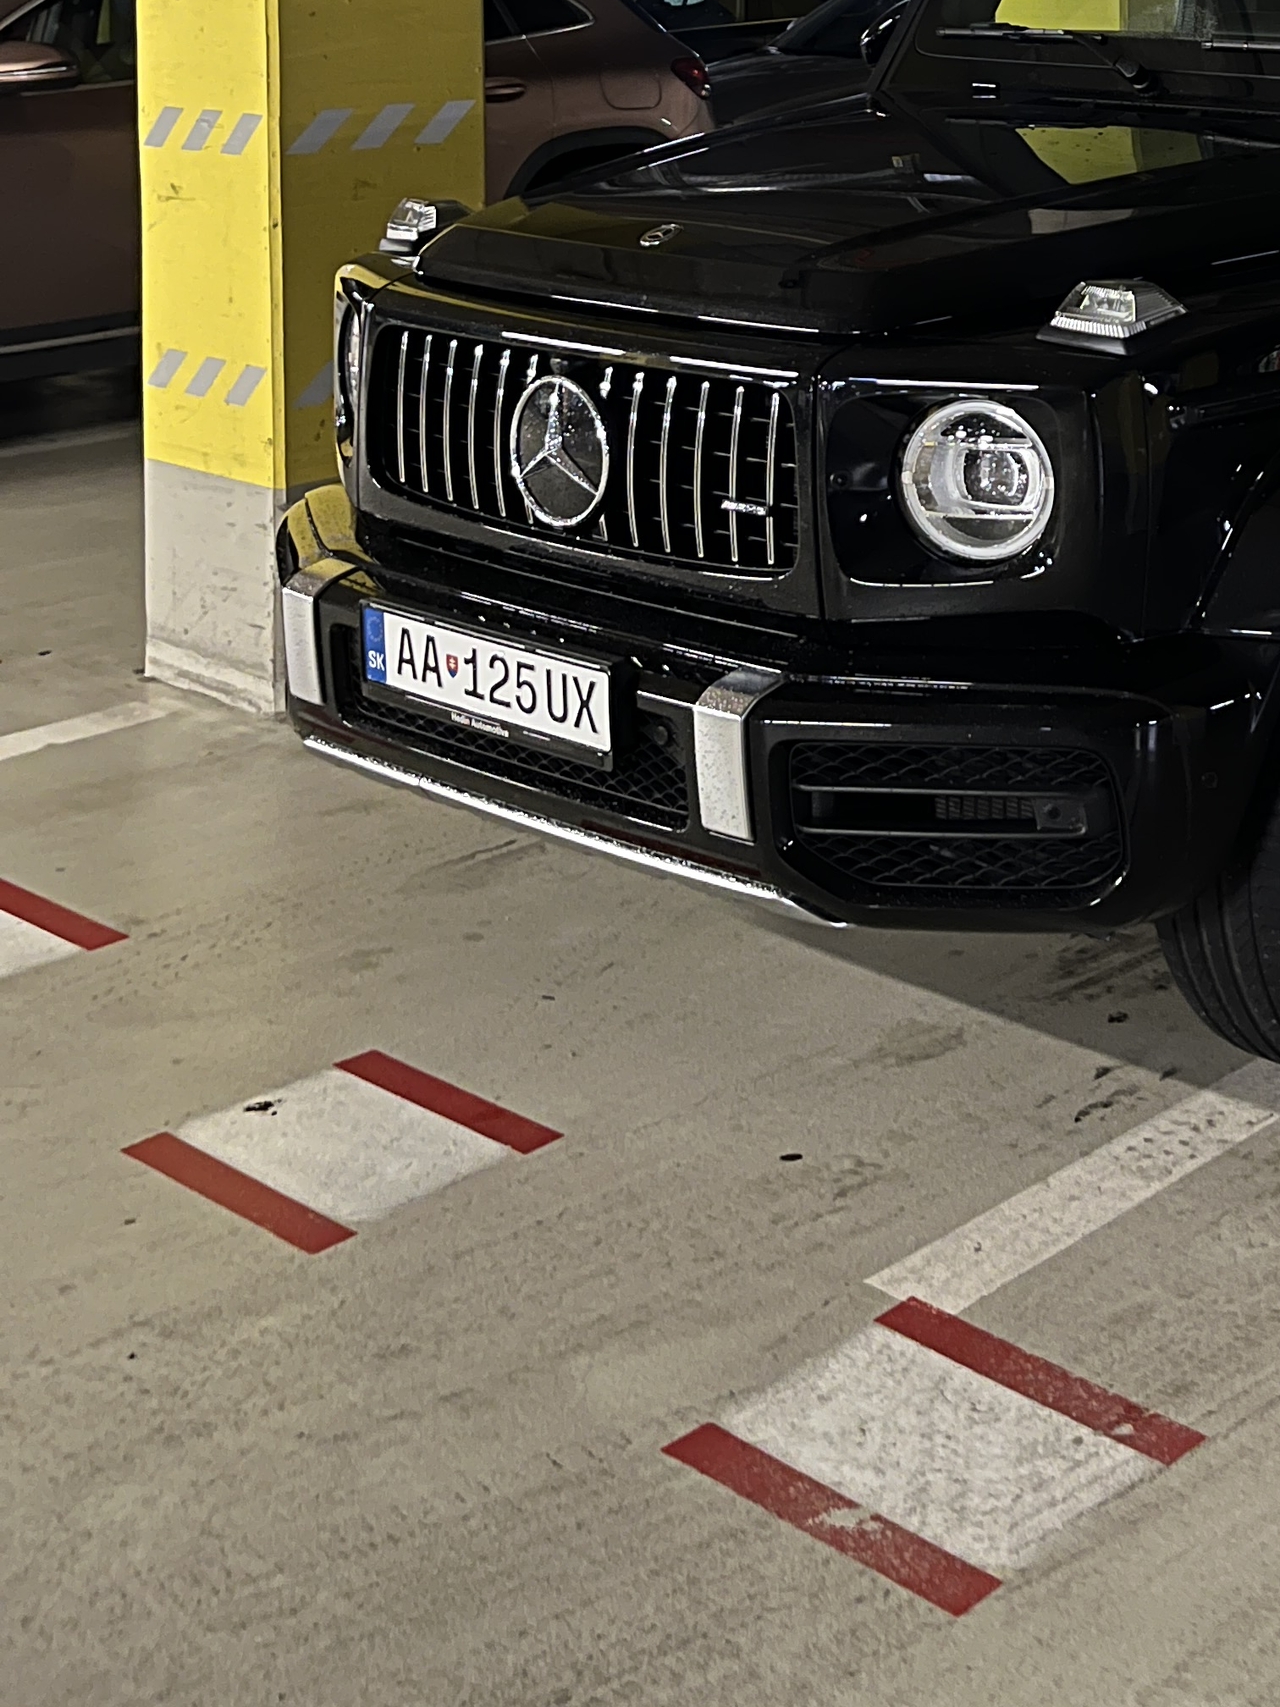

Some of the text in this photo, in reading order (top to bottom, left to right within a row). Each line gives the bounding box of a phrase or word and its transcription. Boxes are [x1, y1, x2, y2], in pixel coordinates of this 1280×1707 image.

[368, 650, 385, 671] SK
[397, 627, 599, 734] AA 125UX
[471, 718, 509, 738] Automotive
